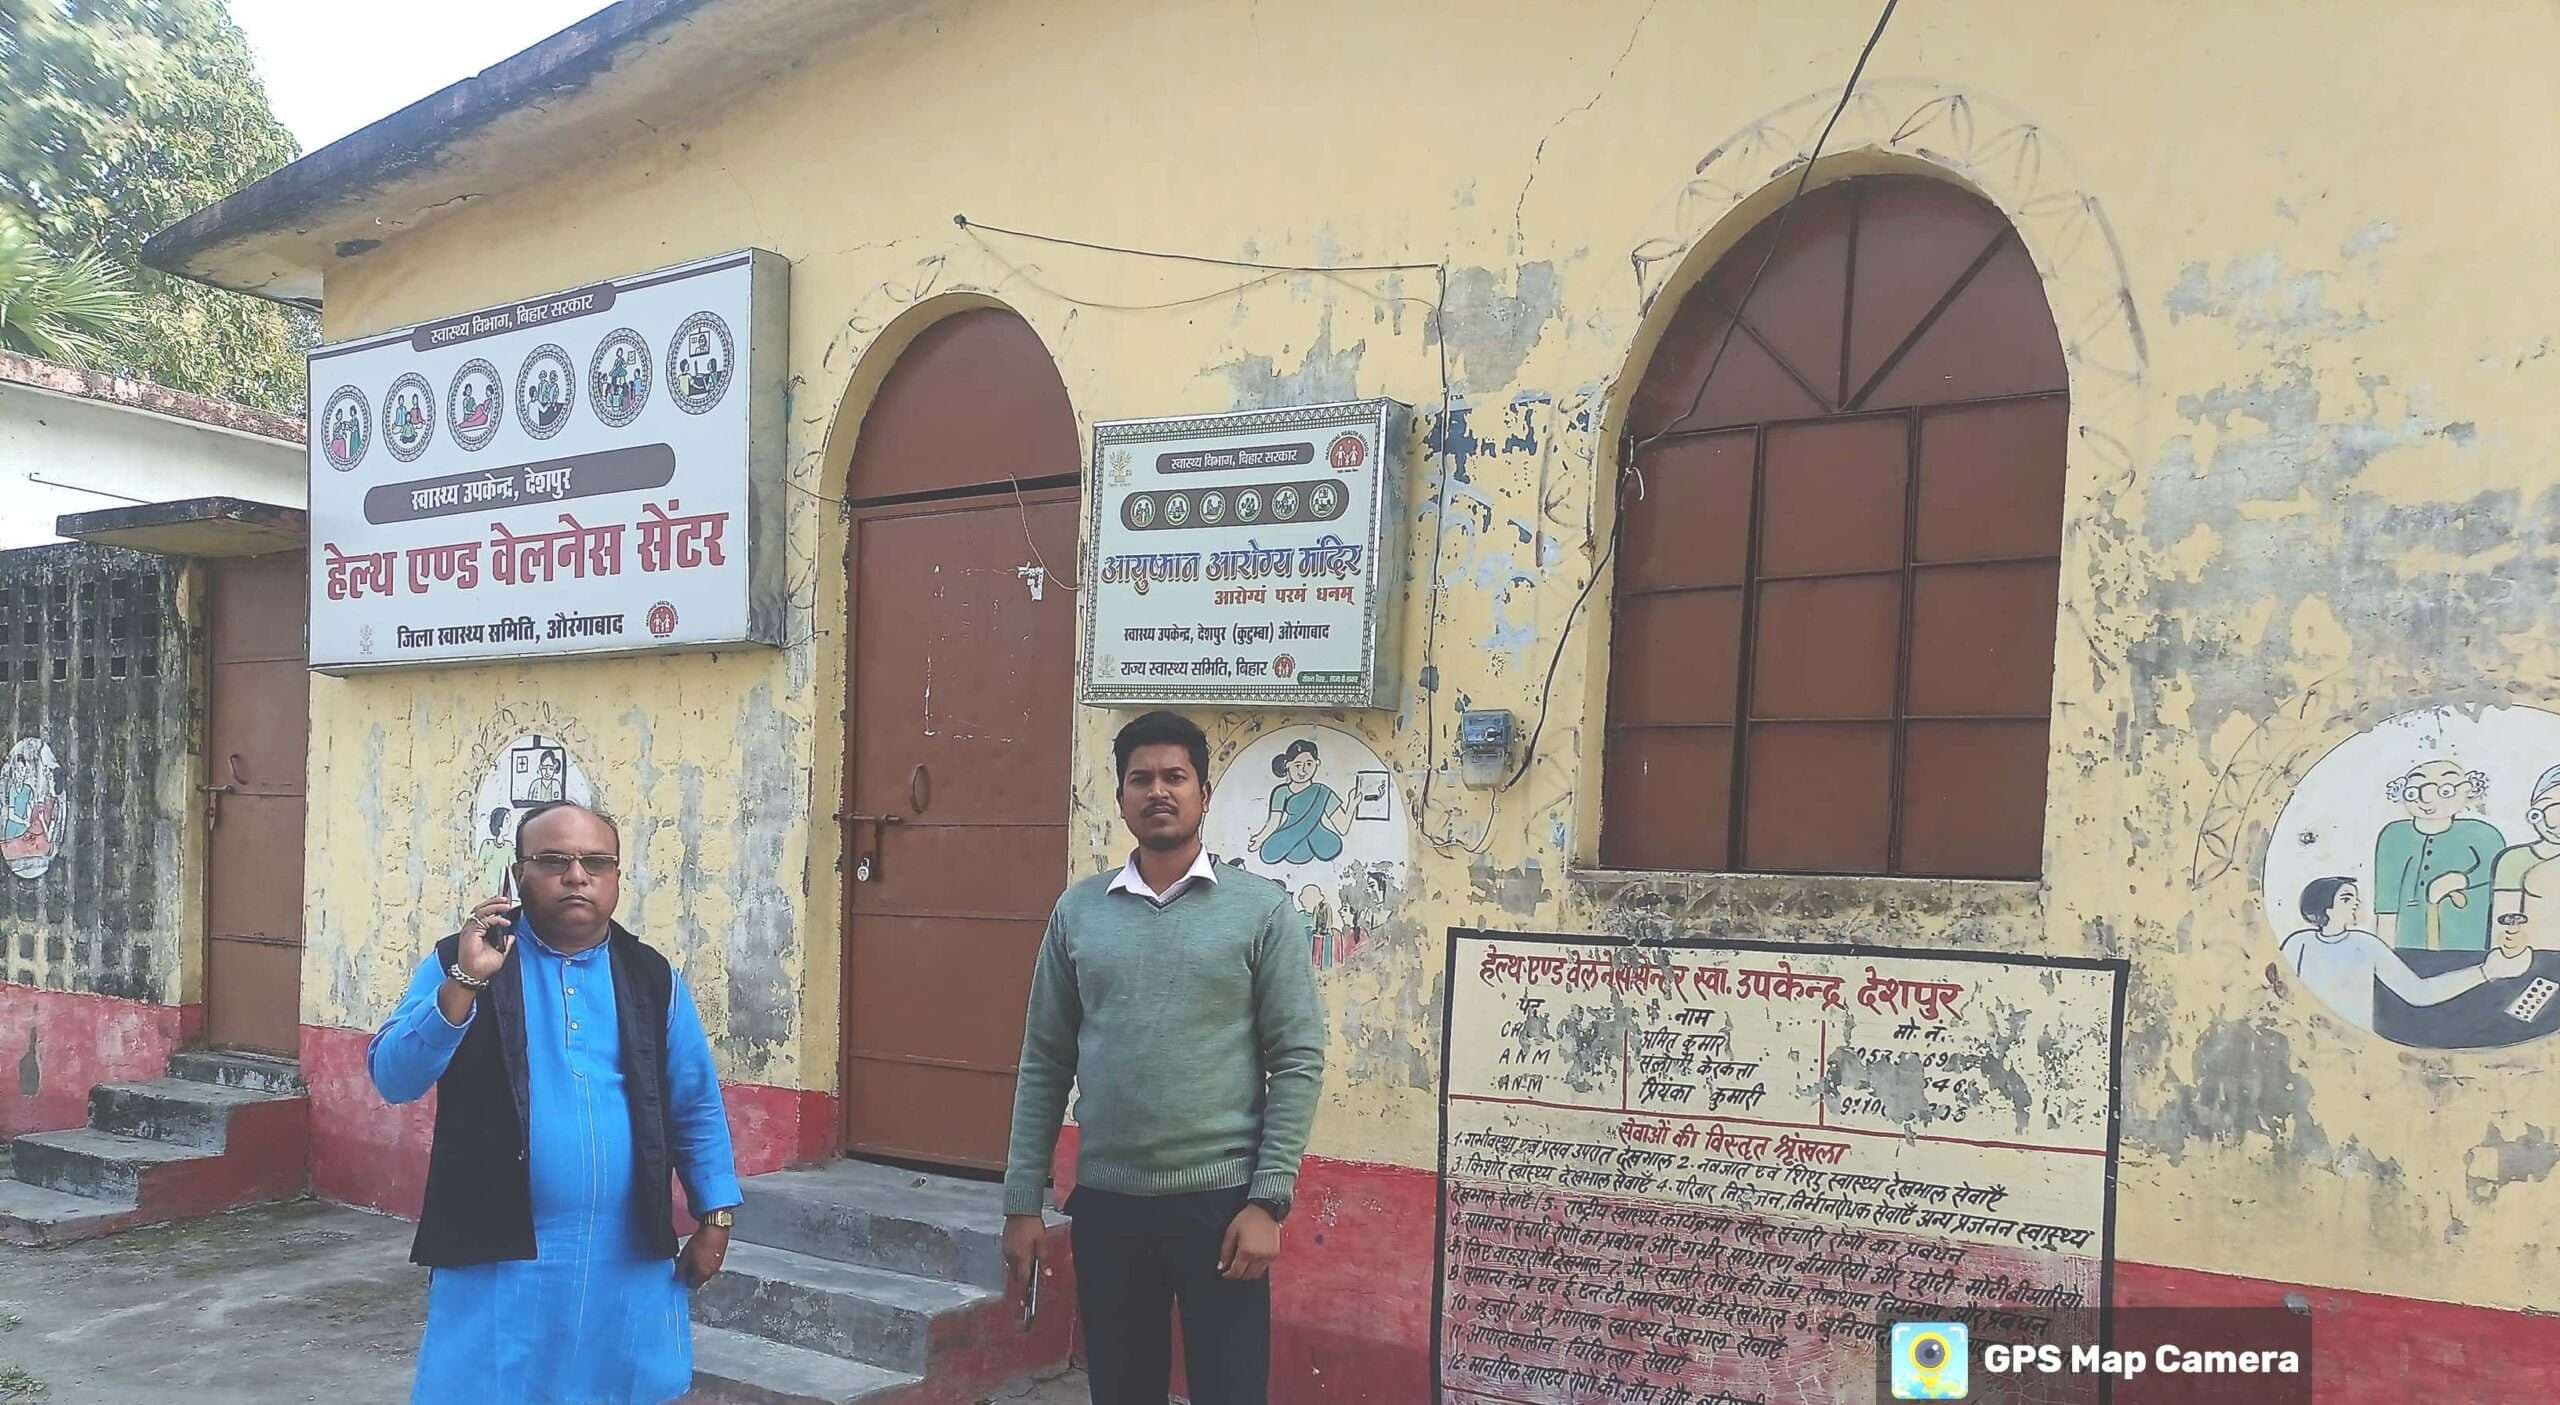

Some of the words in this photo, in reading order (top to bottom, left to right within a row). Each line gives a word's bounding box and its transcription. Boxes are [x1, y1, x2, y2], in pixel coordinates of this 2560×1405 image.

[431, 322, 470, 343] स्वास्थ्य
[472, 315, 513, 335] विभाग,
[517, 305, 548, 324] बिहार
[550, 294, 594, 317] सरकार
[1171, 457, 1201, 470] स्वास्थ्य
[1239, 452, 1263, 465] बिहार
[1265, 449, 1297, 463] सरकार
[411, 485, 460, 510] स्वास्थ्य
[463, 473, 519, 503] उपकेन्द्र,
[524, 466, 572, 499] देशपुर
[324, 543, 397, 600] हेल्थ
[406, 542, 481, 594] एण्ड
[490, 513, 625, 585] वेलनेस
[637, 499, 729, 572] सेंटर
[1101, 552, 1201, 595] आयुष्मान
[1206, 538, 1295, 580] आरोग्य
[1299, 534, 1363, 580] मंदिर
[1215, 585, 1266, 604] आरोग्यं
[1275, 584, 1307, 603] परमं
[1316, 586, 1355, 605] धनम्
[397, 625, 432, 649] जिला
[438, 623, 483, 646] स्वास्थ्य
[488, 617, 540, 644] समिति,
[546, 610, 624, 640] औरंगाबाद
[1124, 627, 1154, 641] स्वास्थ्य
[1197, 624, 1226, 645] देशपुर
[1278, 621, 1330, 640] औरंगाबाद
[1121, 661, 1145, 676] राज्य
[1149, 661, 1188, 676] स्वास्थ्य
[1191, 657, 1231, 678] समिति,
[1236, 657, 1267, 676] बिहार
[1480, 944, 1525, 987] हेल्थ
[1525, 955, 1568, 985] एण्ड
[1737, 961, 1846, 1011] उपकेन्द्र
[1858, 965, 1964, 1021] देशपुर
[1675, 1008, 1715, 1027] नाम
[1641, 1026, 1682, 1053] अमित
[1682, 1035, 1726, 1057] कुमार
[1709, 1083, 1766, 1111] कुमारी
[1618, 1118, 1671, 1145] सेवाओं
[1672, 1123, 1701, 1148] की
[1705, 1123, 1773, 1161] विस्तृत
[1465, 1151, 1508, 1179] किशोर
[1558, 1164, 1613, 1189] देखभाल
[1916, 1210, 1958, 1229] अन्य
[1950, 1214, 2019, 1237] प्रजनन
[1617, 1144, 1677, 1172] देखभाल
[1697, 1157, 1753, 1180] नवजात
[1755, 1163, 1782, 1181] एवं
[1885, 1171, 1952, 1204] देखभाल
